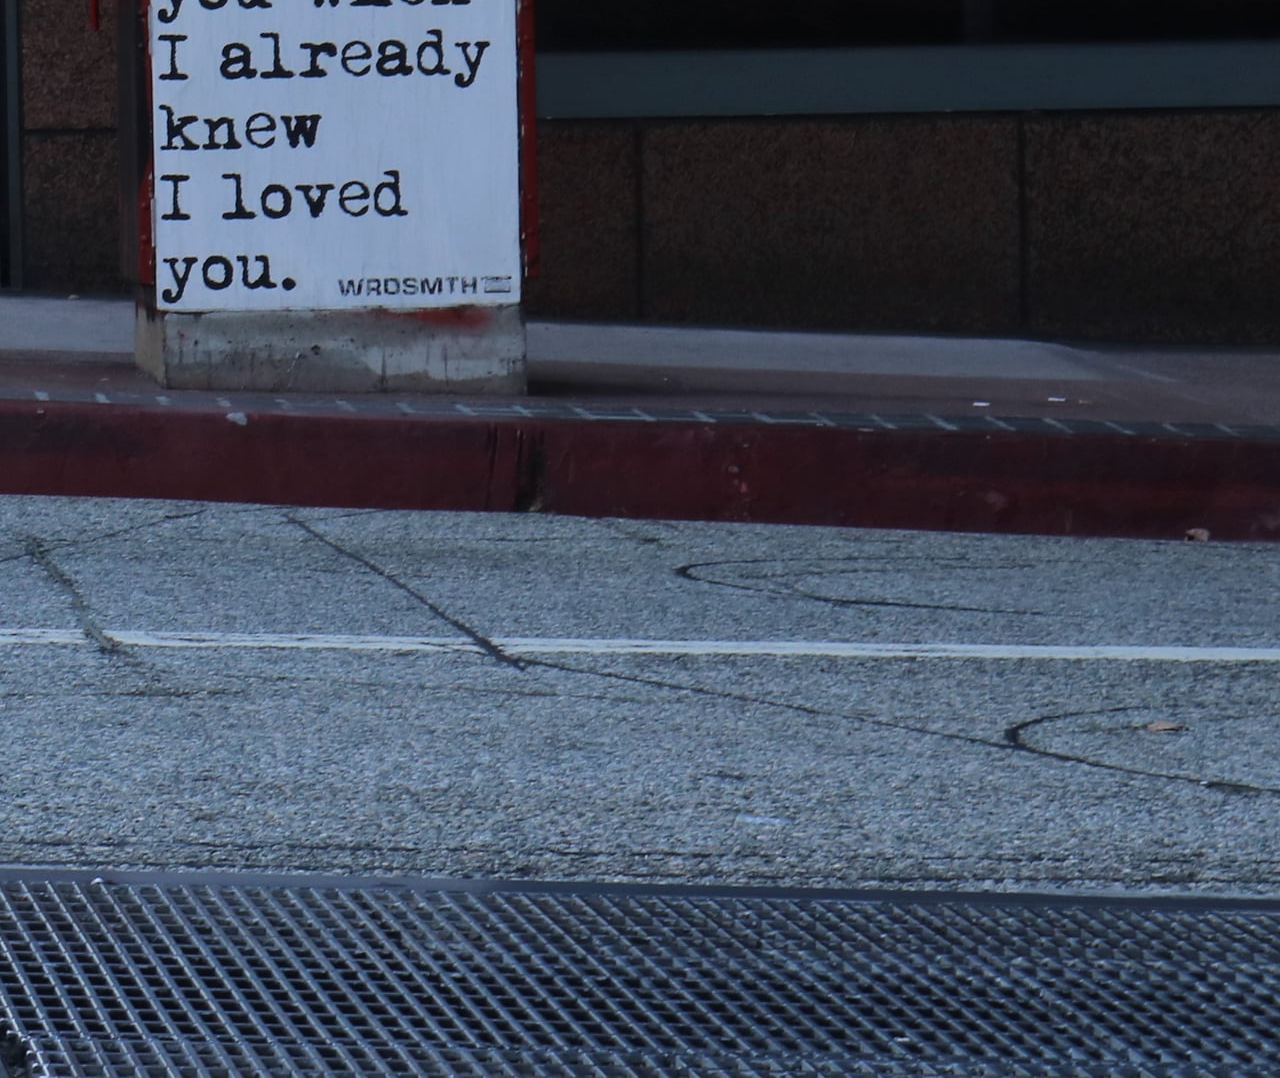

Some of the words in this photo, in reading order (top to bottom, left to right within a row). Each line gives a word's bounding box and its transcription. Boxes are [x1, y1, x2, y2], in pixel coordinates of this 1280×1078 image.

[157, 34, 189, 81] I
[219, 28, 491, 89] already
[158, 104, 322, 151] knew
[159, 174, 191, 221] I
[221, 169, 409, 221] loved
[161, 254, 297, 305] you.
[338, 275, 478, 297] WRDSMTH
